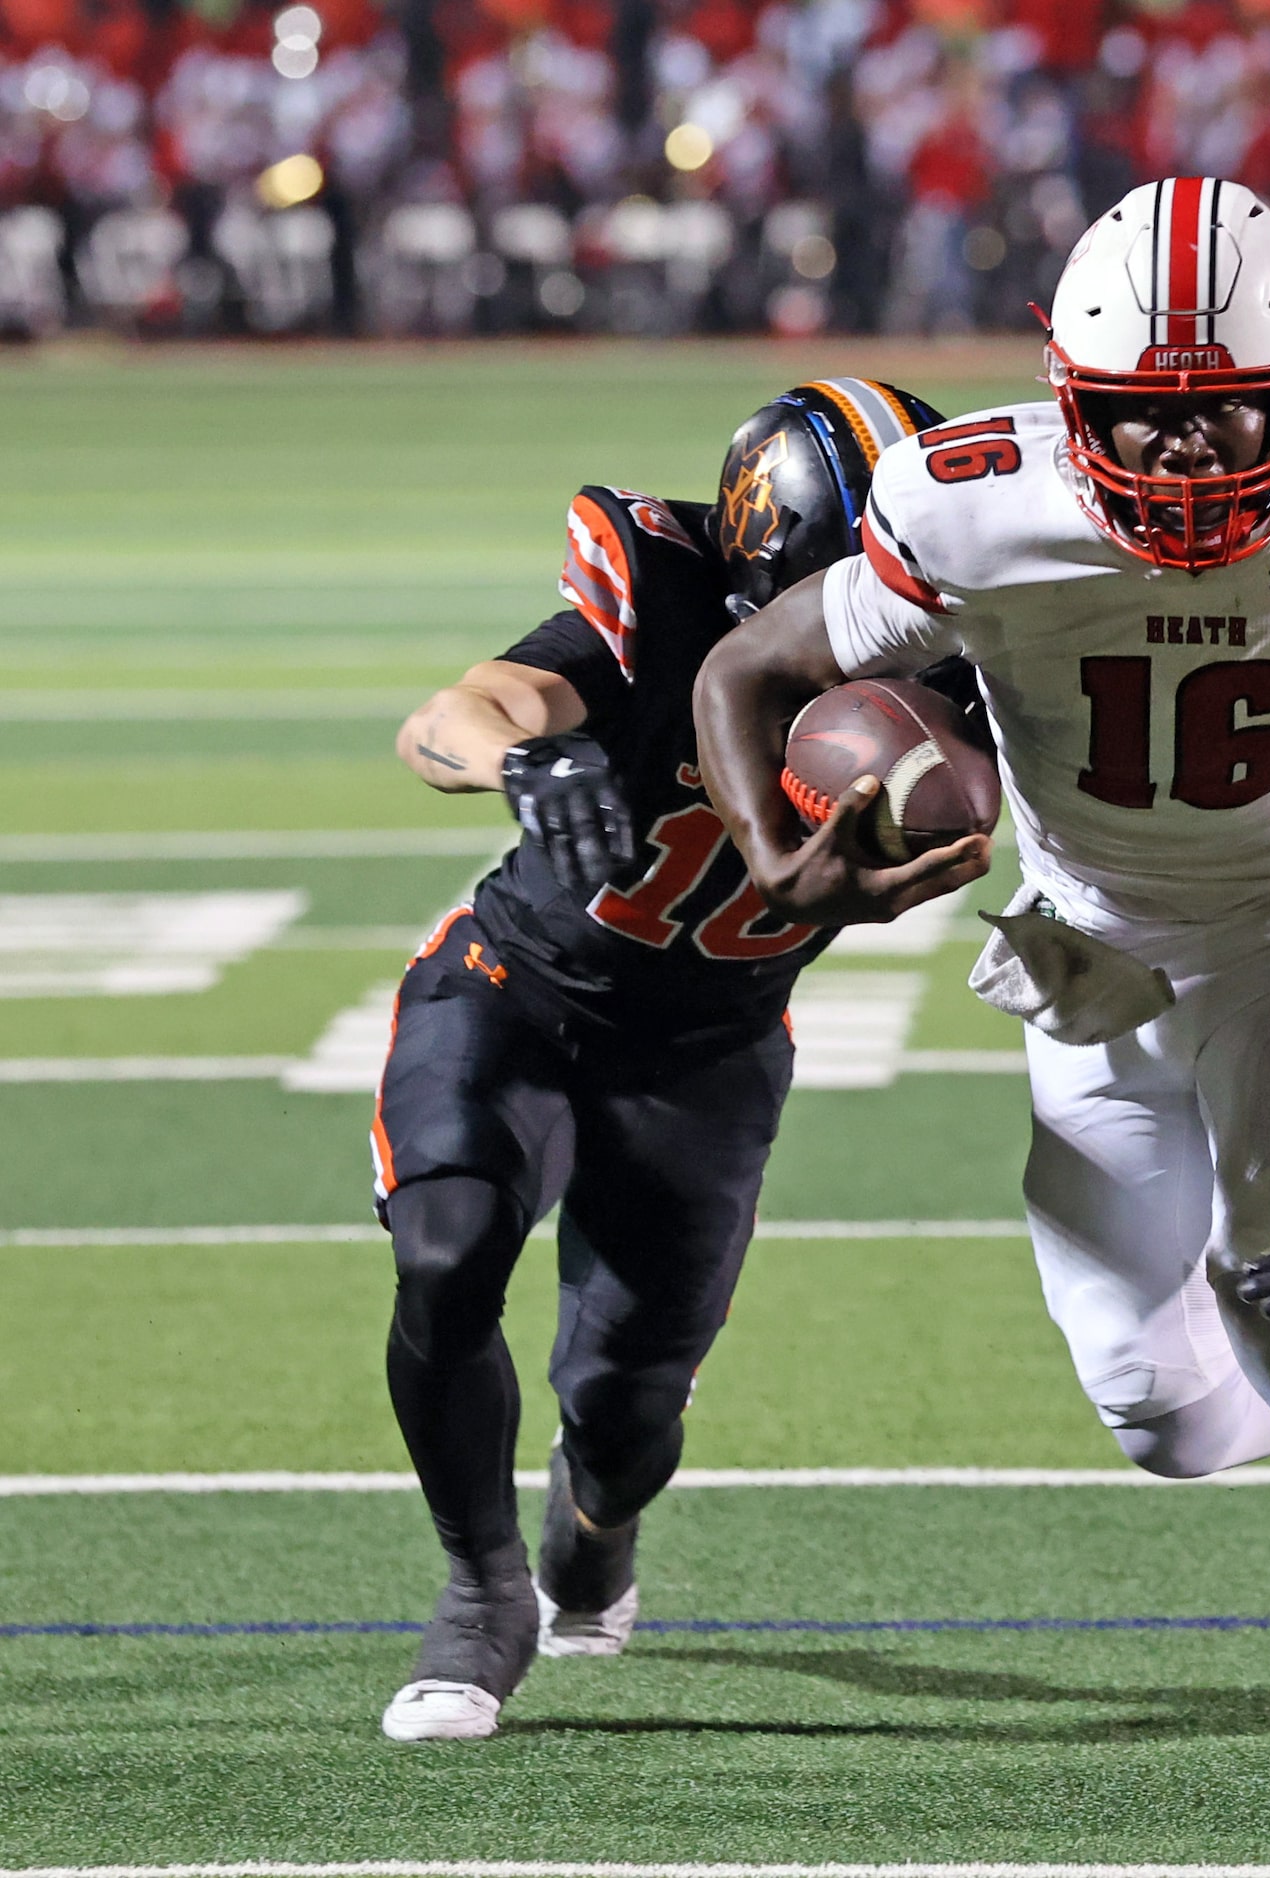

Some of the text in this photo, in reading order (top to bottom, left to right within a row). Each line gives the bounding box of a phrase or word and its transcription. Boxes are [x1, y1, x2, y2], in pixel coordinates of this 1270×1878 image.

[1155, 351, 1220, 371] HEATH
[917, 416, 1022, 485] 16
[1146, 615, 1248, 647] HEATH
